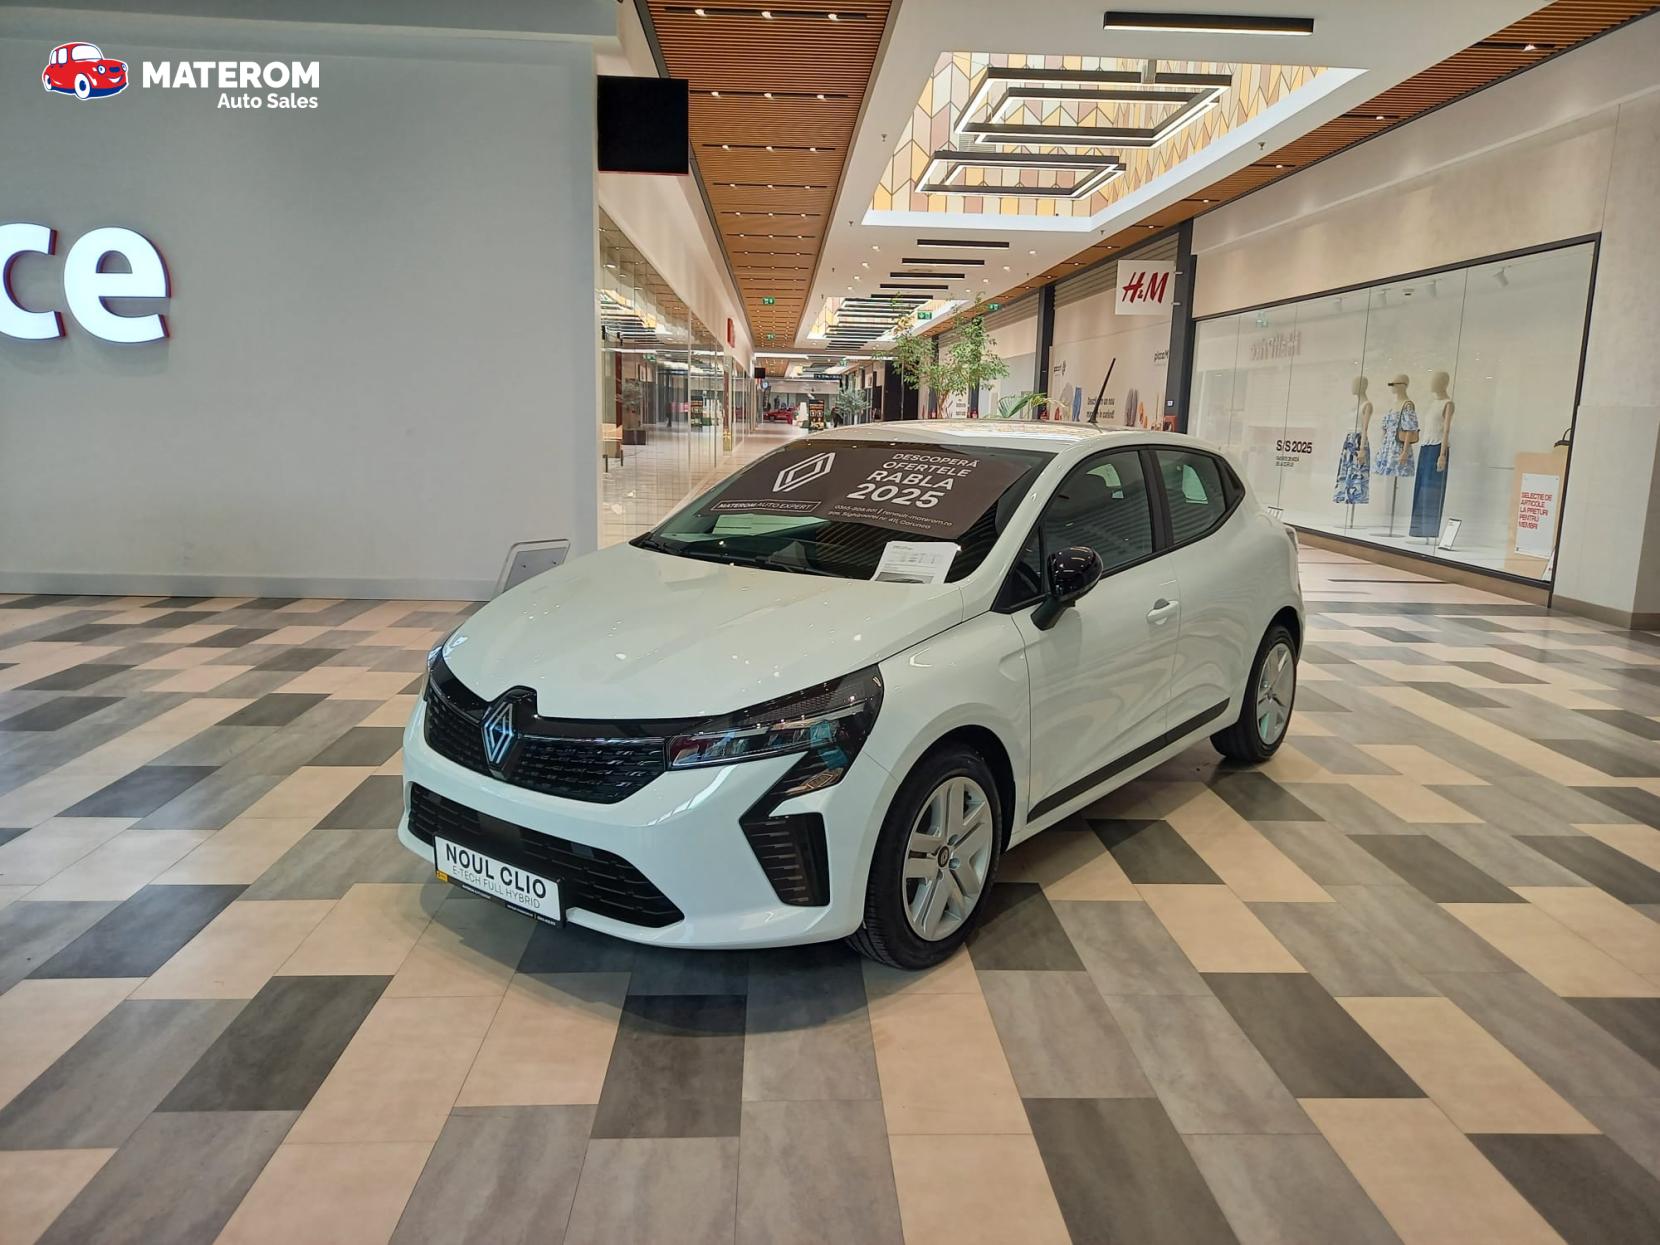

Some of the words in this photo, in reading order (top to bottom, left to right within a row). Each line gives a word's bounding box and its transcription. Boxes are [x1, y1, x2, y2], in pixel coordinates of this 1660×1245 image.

[0, 223, 171, 343] ce
[1122, 271, 1170, 304] H&M
[1292, 441, 1313, 454] 2025
[866, 470, 954, 490] RABLA
[882, 461, 971, 477] OFERTELE
[846, 483, 945, 508] 2025
[1520, 500, 1545, 508] ARTICOLE
[446, 843, 495, 880] NOUL
[500, 866, 547, 899] CLIO
[452, 865, 481, 884] E-TECH
[483, 879, 504, 898] FULL
[506, 888, 541, 909] HYBRID
